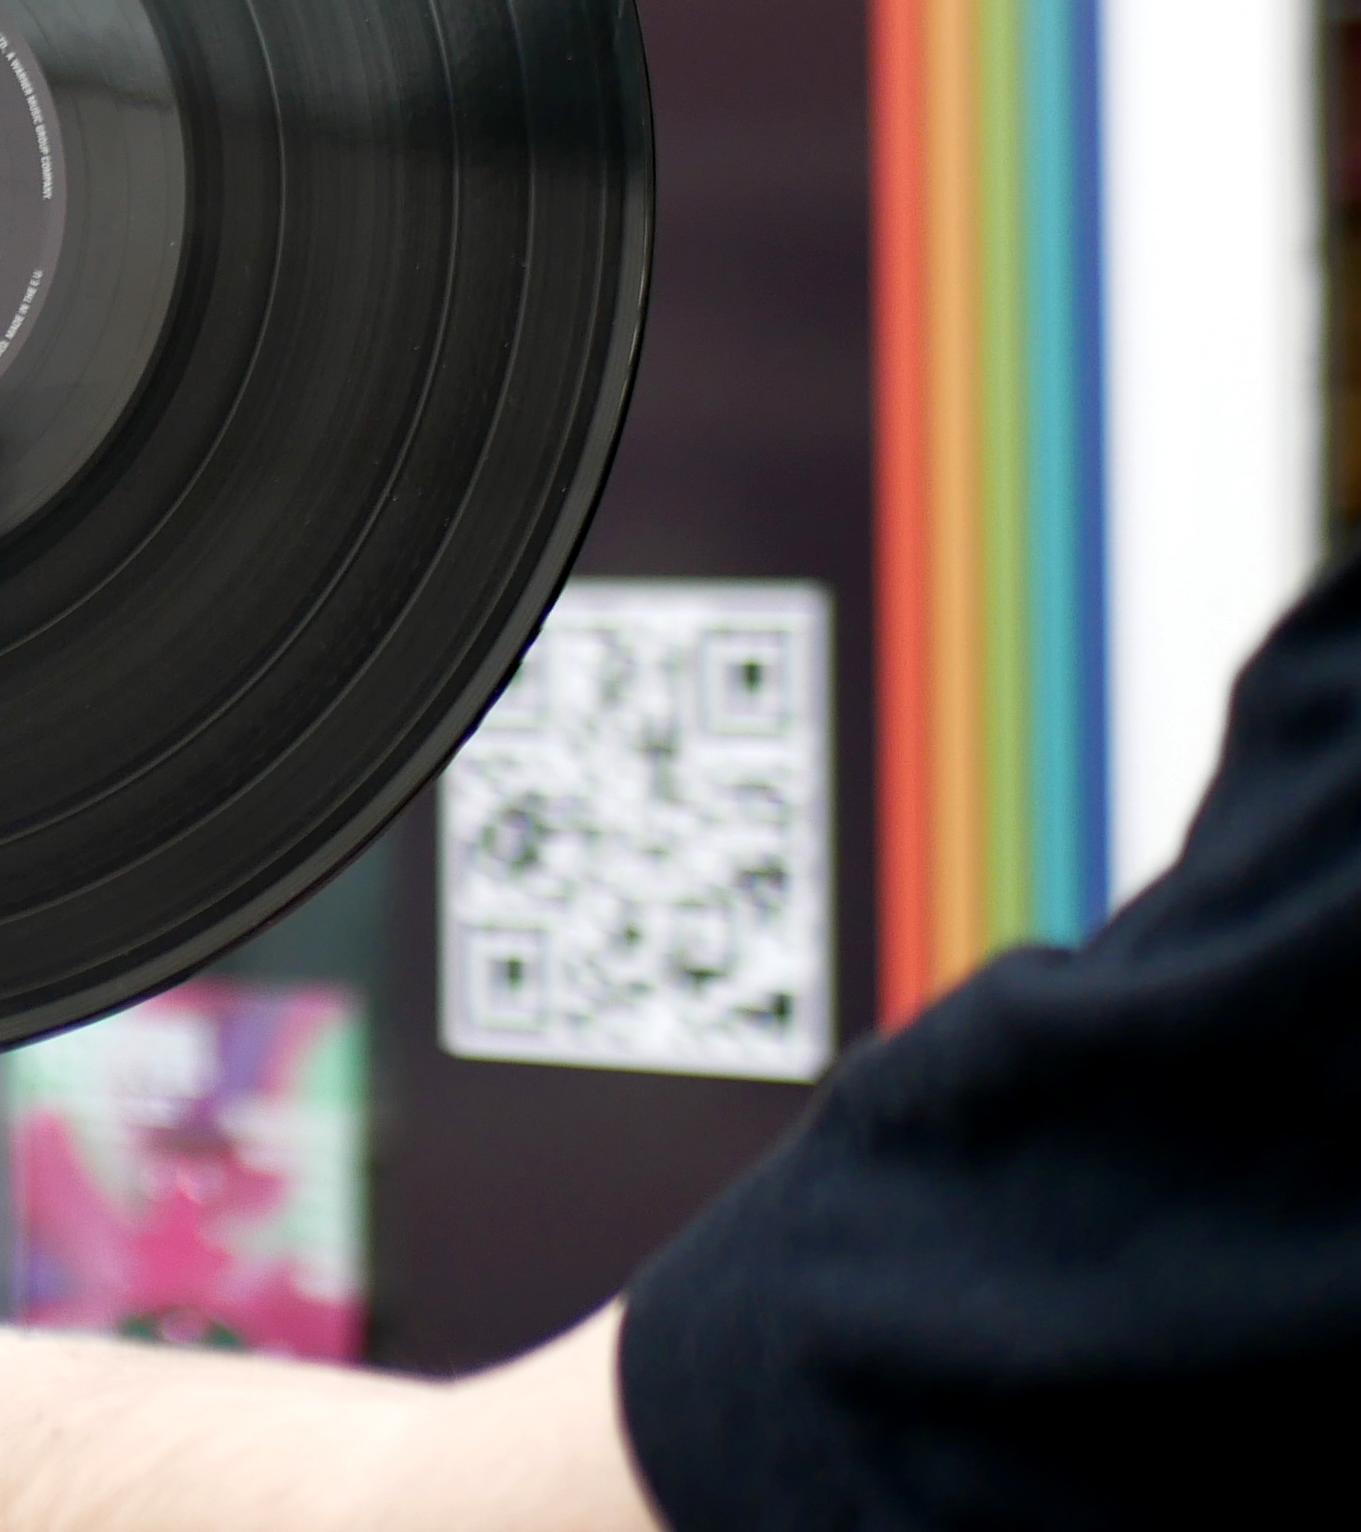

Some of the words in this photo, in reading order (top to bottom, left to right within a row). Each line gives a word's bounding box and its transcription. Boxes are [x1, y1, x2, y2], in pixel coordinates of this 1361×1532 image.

[5, 50, 16, 61] A
[9, 57, 33, 95] WARNER
[26, 94, 43, 124] MUSIC
[35, 123, 50, 154] GROUP
[21, 285, 36, 304] THE
[17, 302, 29, 315] IN
[3, 313, 24, 340] MADE
